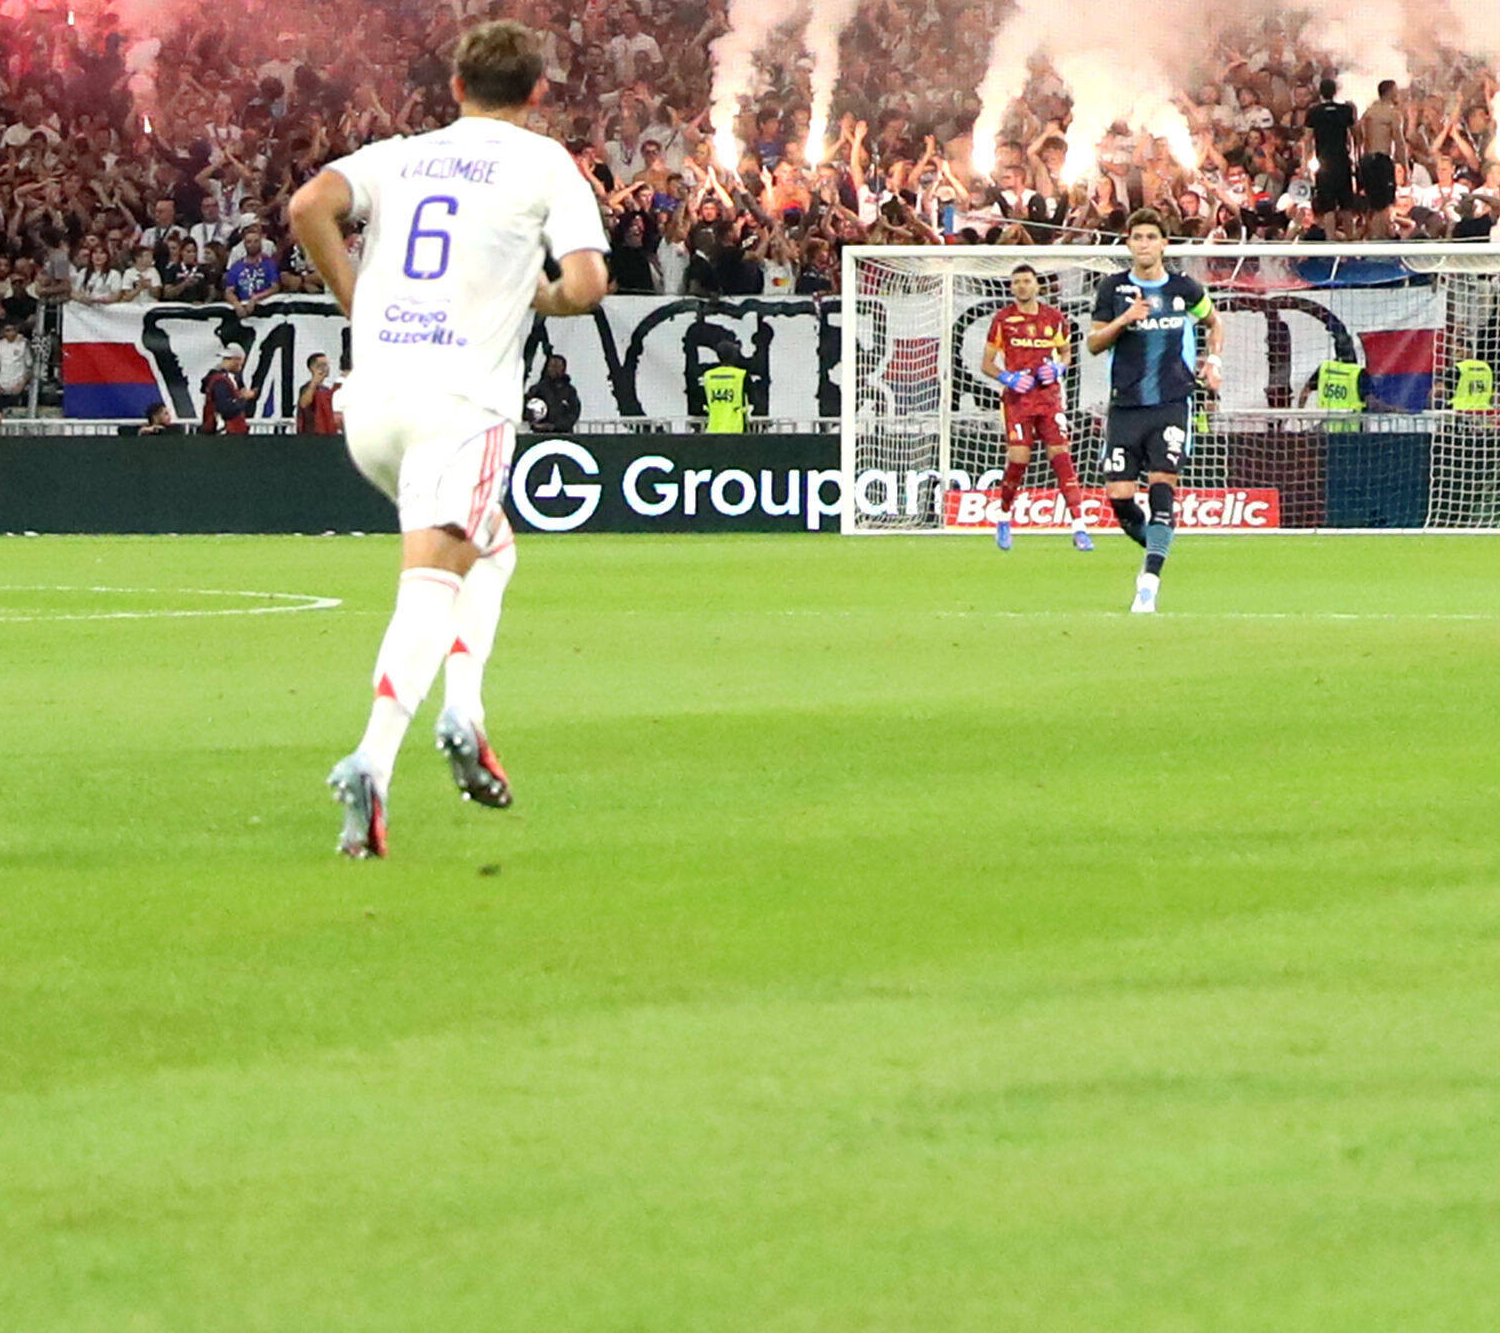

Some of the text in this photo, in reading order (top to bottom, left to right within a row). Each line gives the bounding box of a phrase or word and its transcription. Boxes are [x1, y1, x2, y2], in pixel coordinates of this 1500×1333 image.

[401, 156, 501, 184] LACOMBE
[403, 194, 459, 280] 6
[385, 305, 448, 328] Congo
